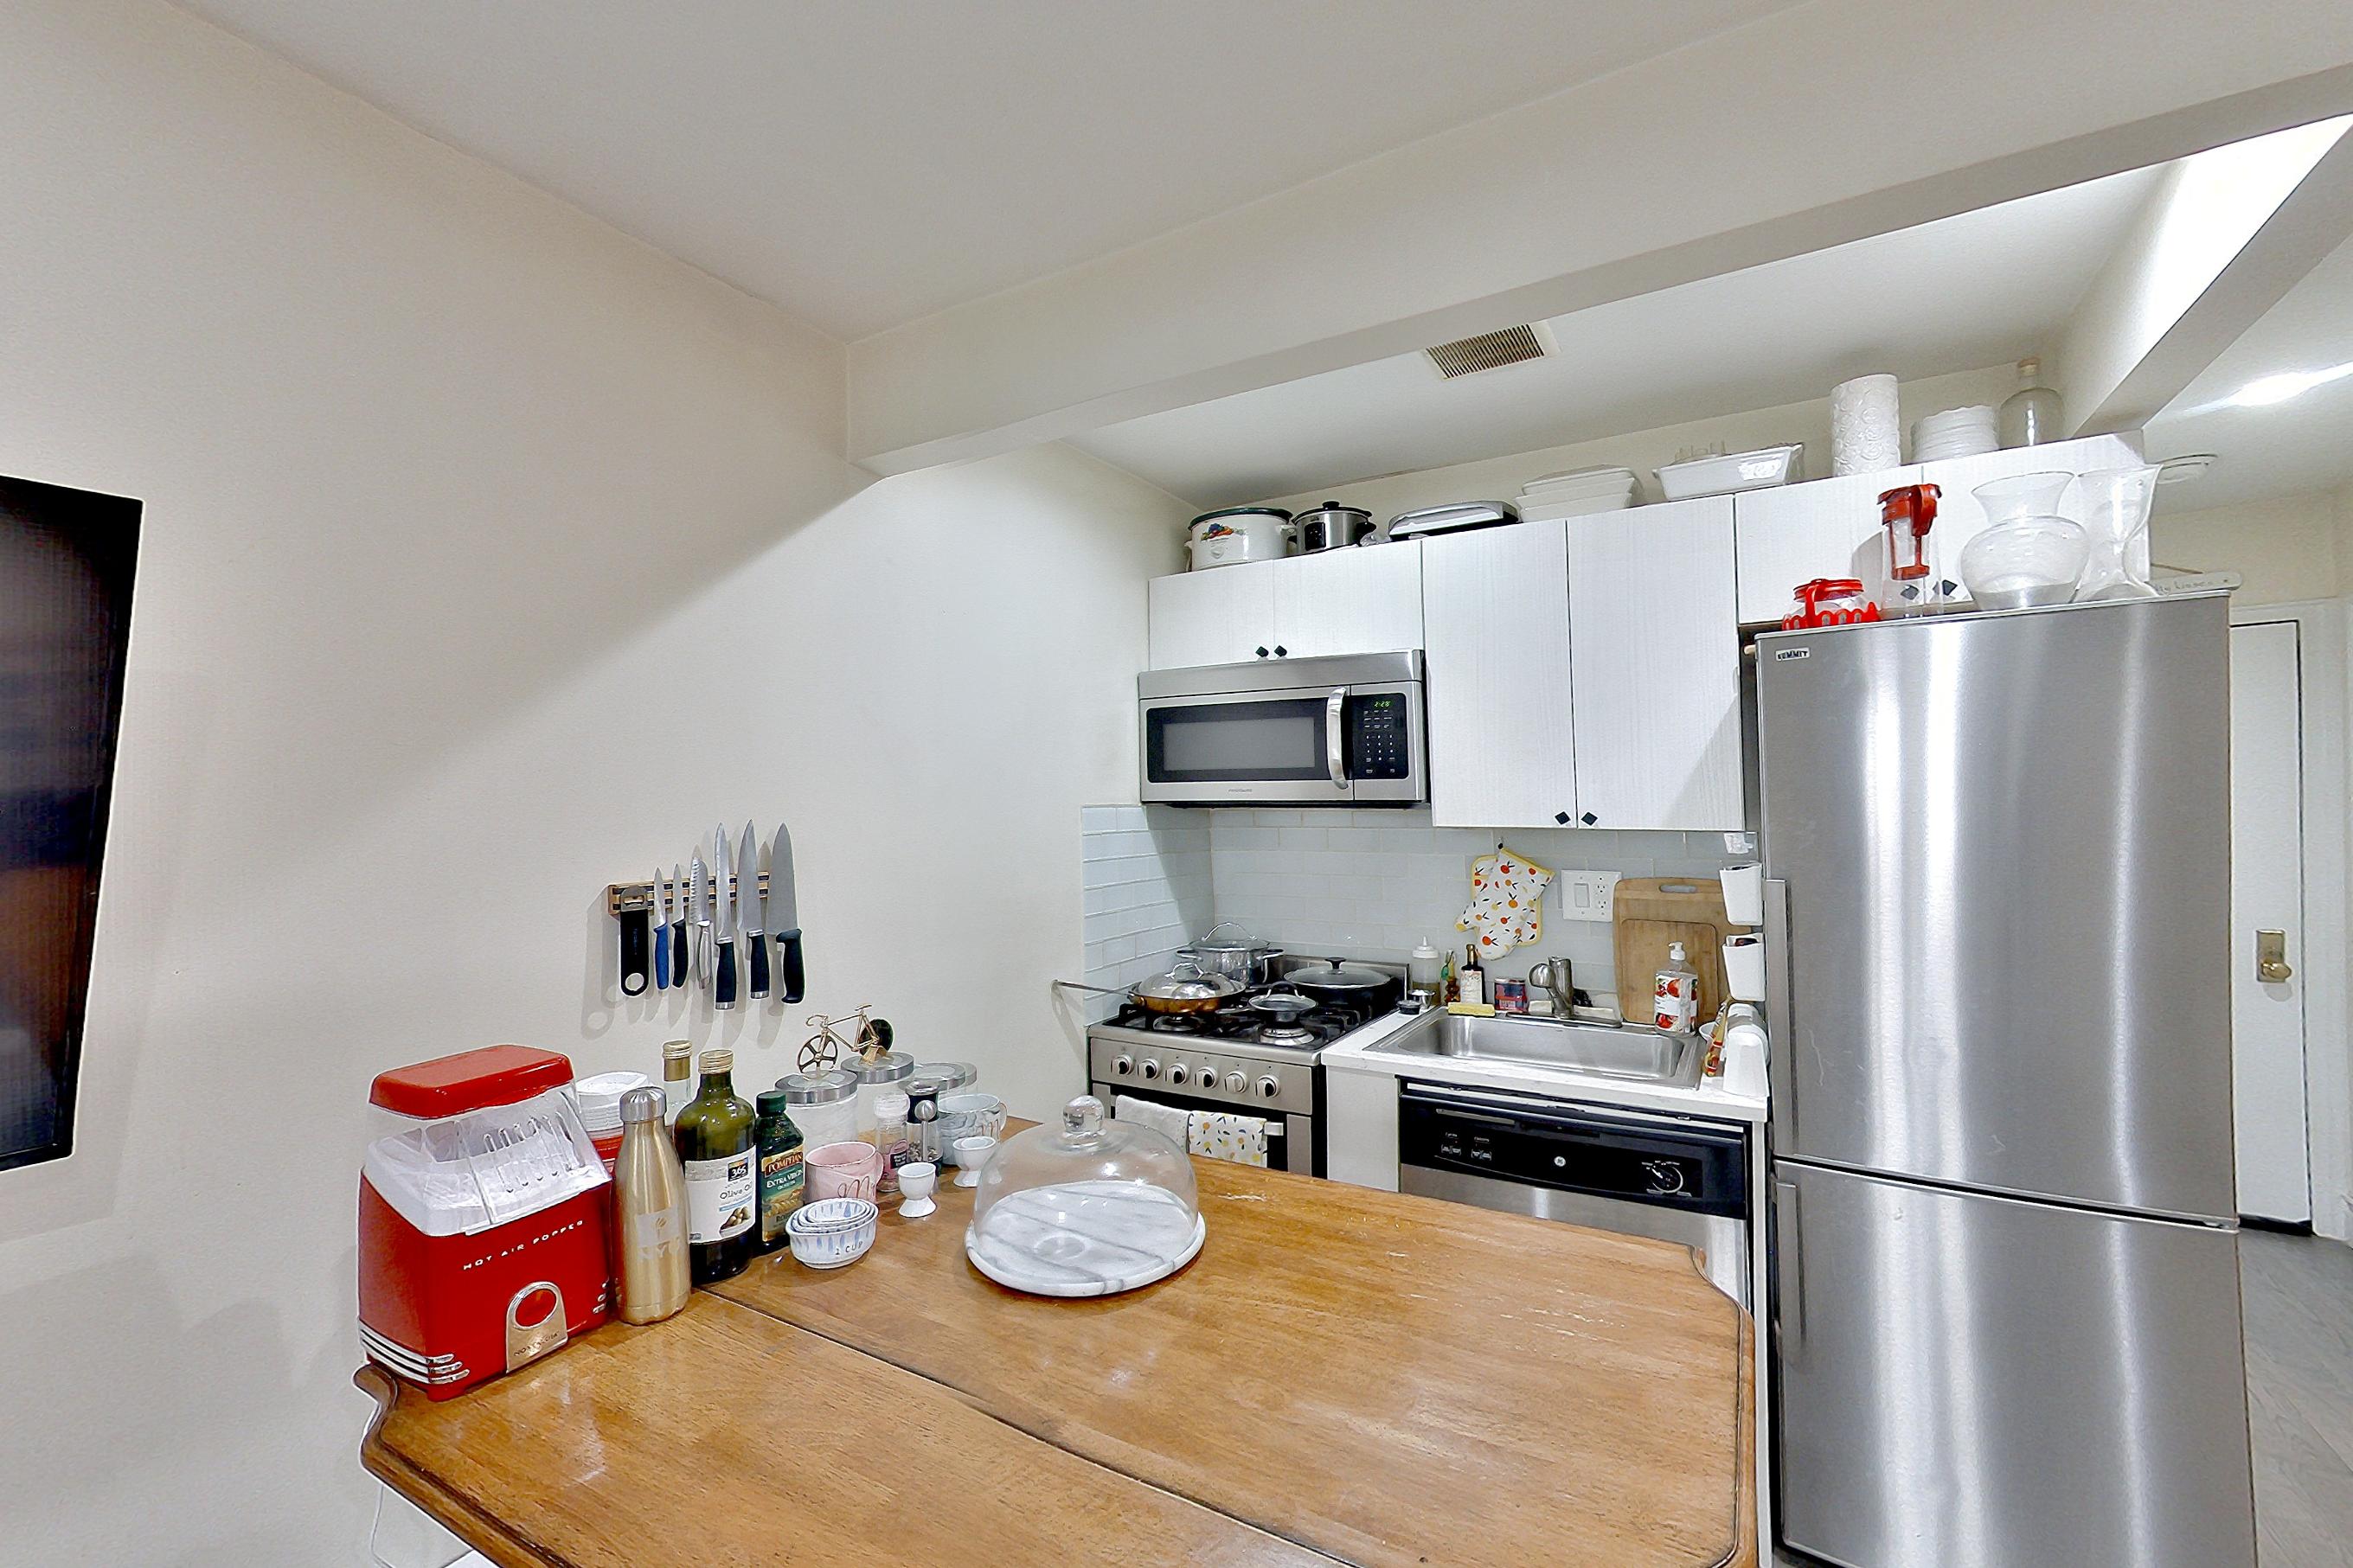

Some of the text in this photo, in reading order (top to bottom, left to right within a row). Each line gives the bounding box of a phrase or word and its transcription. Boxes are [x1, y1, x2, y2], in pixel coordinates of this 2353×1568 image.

[1777, 650, 1808, 660] SUMMIT
[731, 1165, 747, 1178] 365
[766, 1177, 787, 1188] EXTRA
[720, 1188, 743, 1200] Olive
[463, 1220, 583, 1270] HOT AIR POPPER
[845, 1240, 863, 1252] CUP
